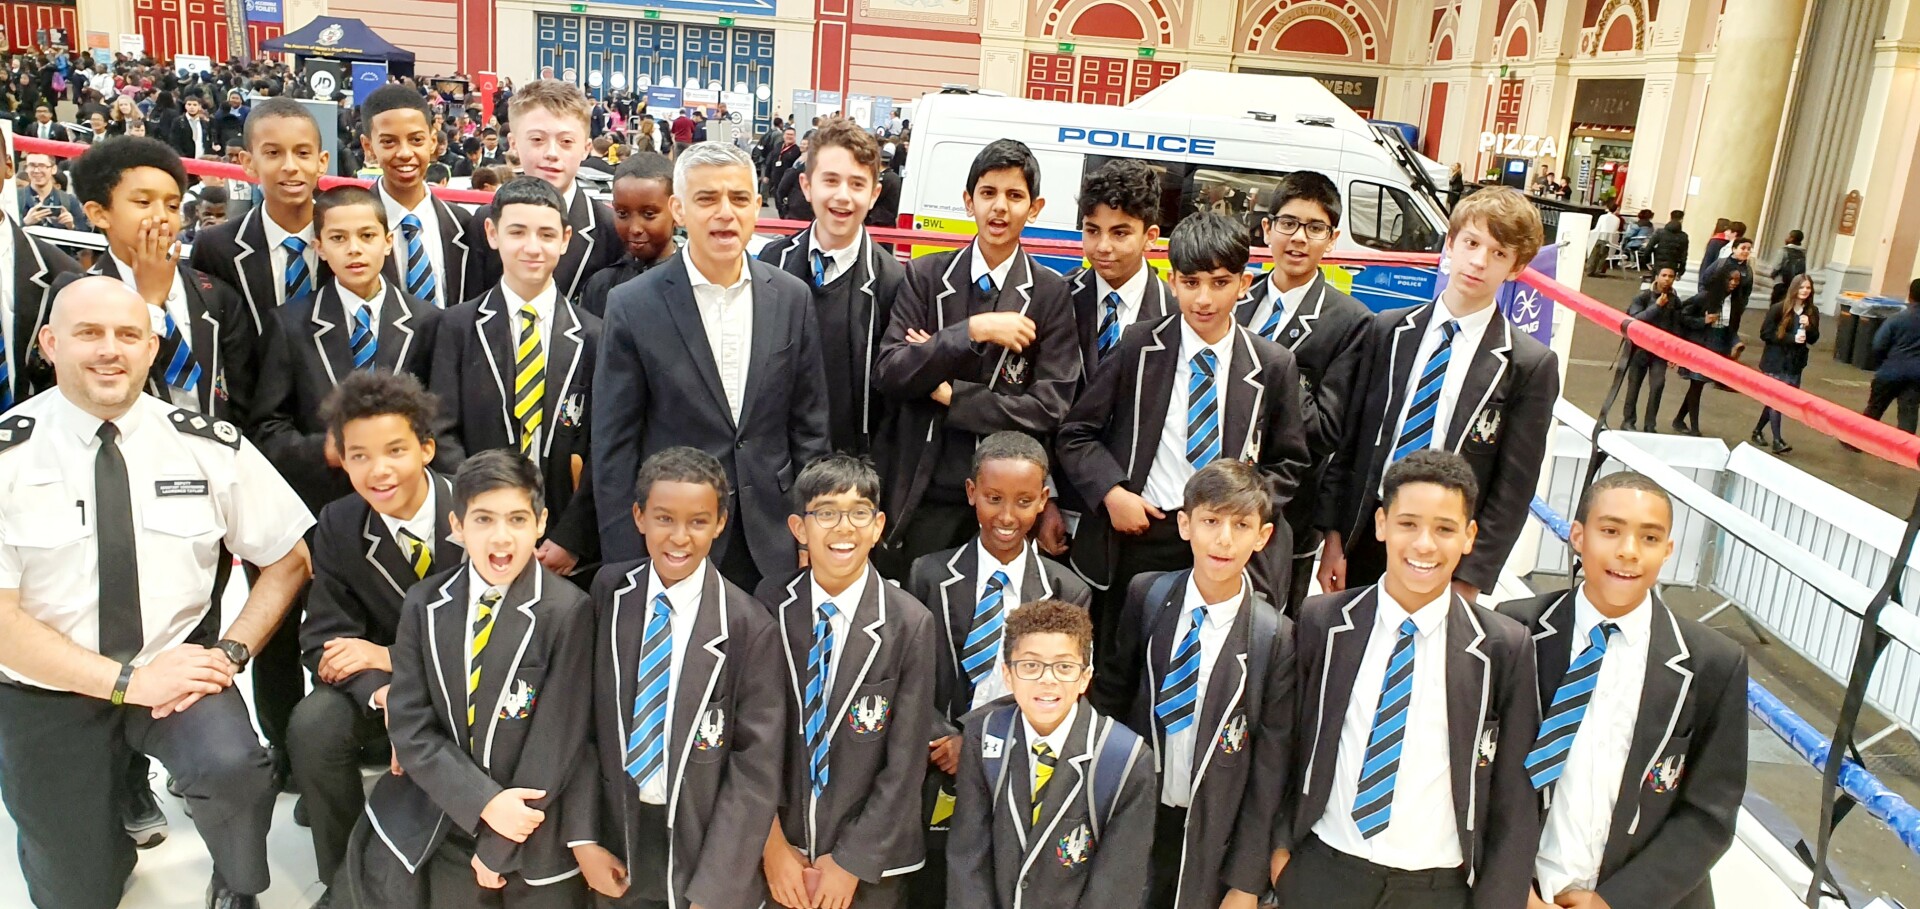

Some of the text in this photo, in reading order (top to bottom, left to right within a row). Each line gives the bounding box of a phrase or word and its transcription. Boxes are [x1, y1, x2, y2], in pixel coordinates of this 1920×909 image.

[314, 76, 332, 88] JD
[1058, 127, 1216, 156] POLICE
[1478, 131, 1557, 158] PIZZA
[923, 219, 944, 228] BWL
